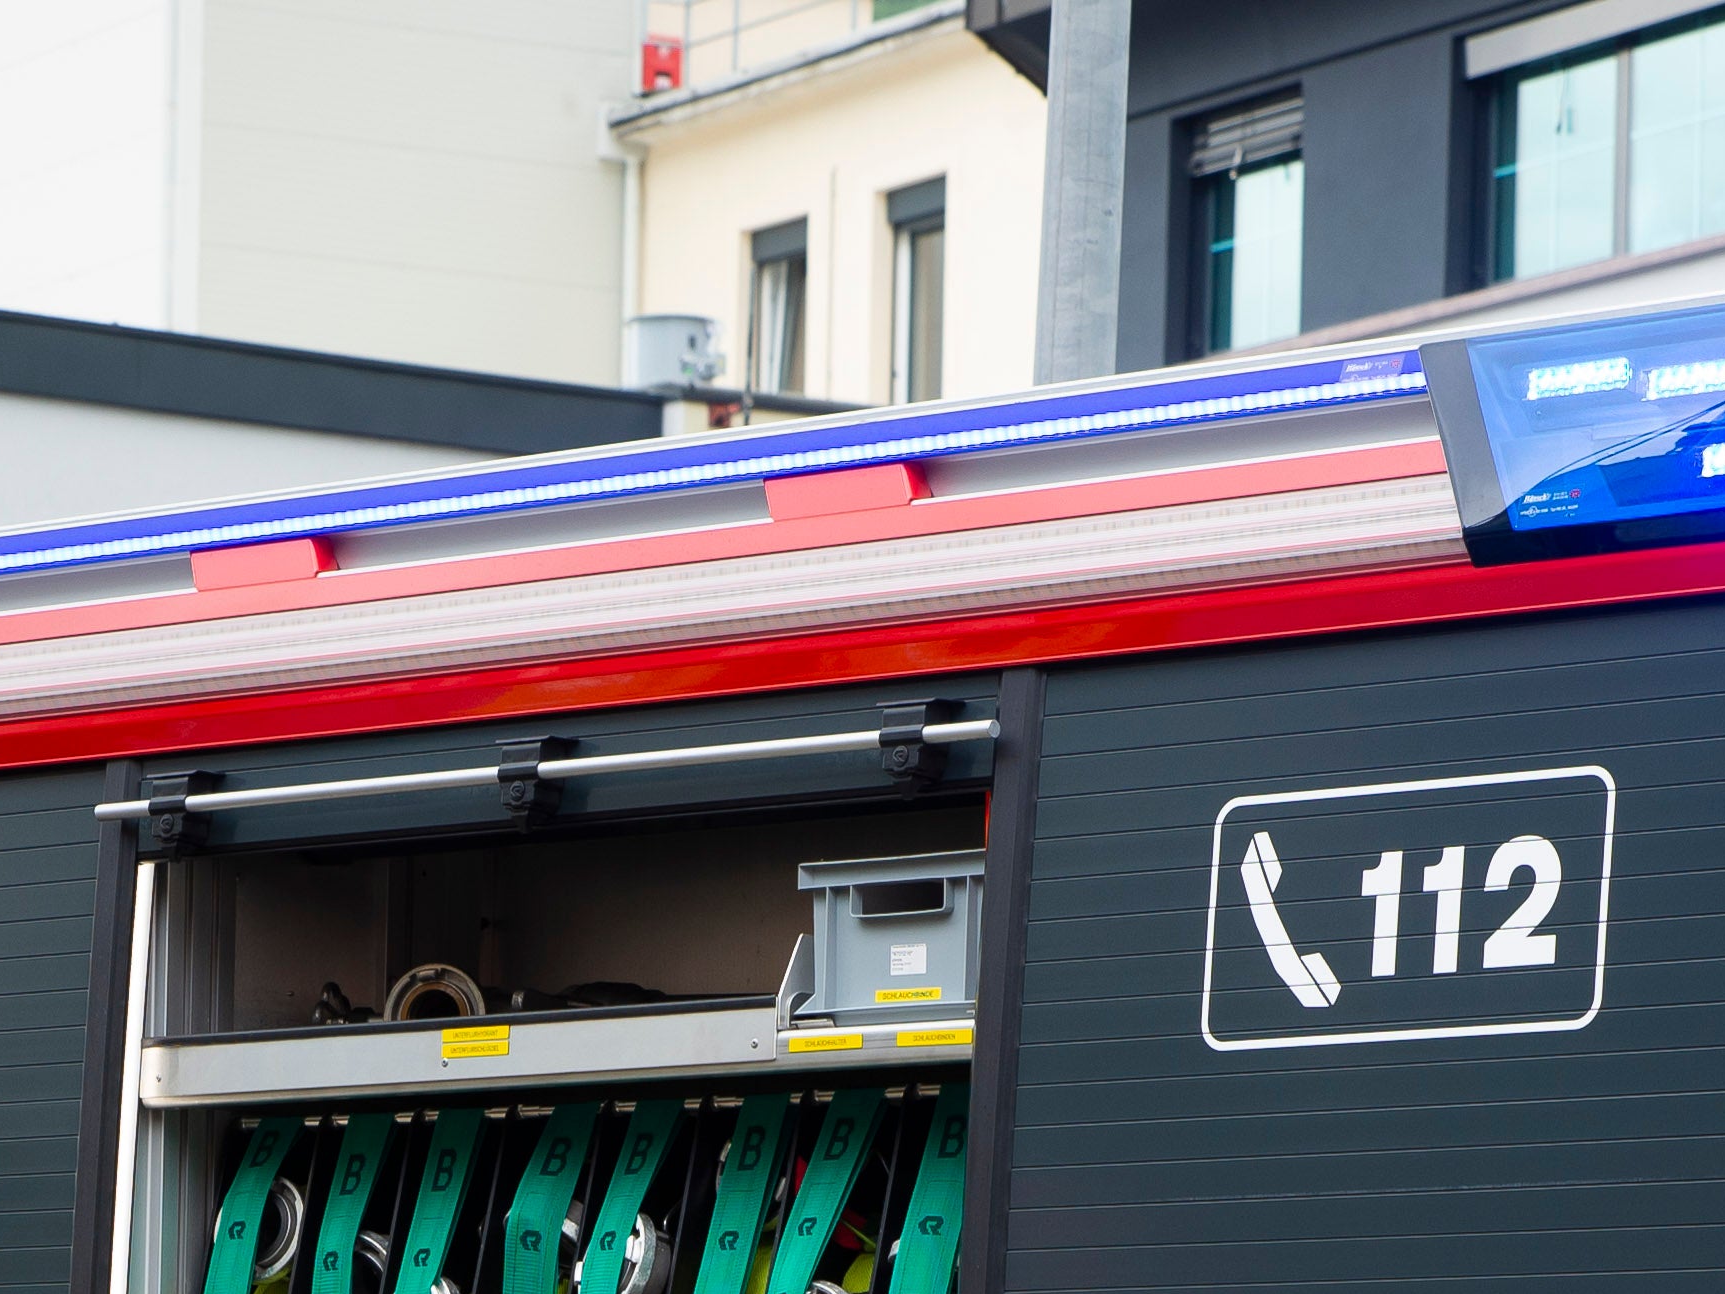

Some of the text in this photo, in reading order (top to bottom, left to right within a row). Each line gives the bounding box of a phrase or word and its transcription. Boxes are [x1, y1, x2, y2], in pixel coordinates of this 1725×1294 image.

[1362, 834, 1562, 977] 112
[249, 1131, 280, 1167] B
[540, 1137, 572, 1176] B
[625, 1133, 653, 1175] B
[737, 1126, 765, 1170] B
[824, 1118, 855, 1160] B
[938, 1115, 966, 1158] B
[339, 1154, 366, 1195] B
[431, 1149, 457, 1191] B
